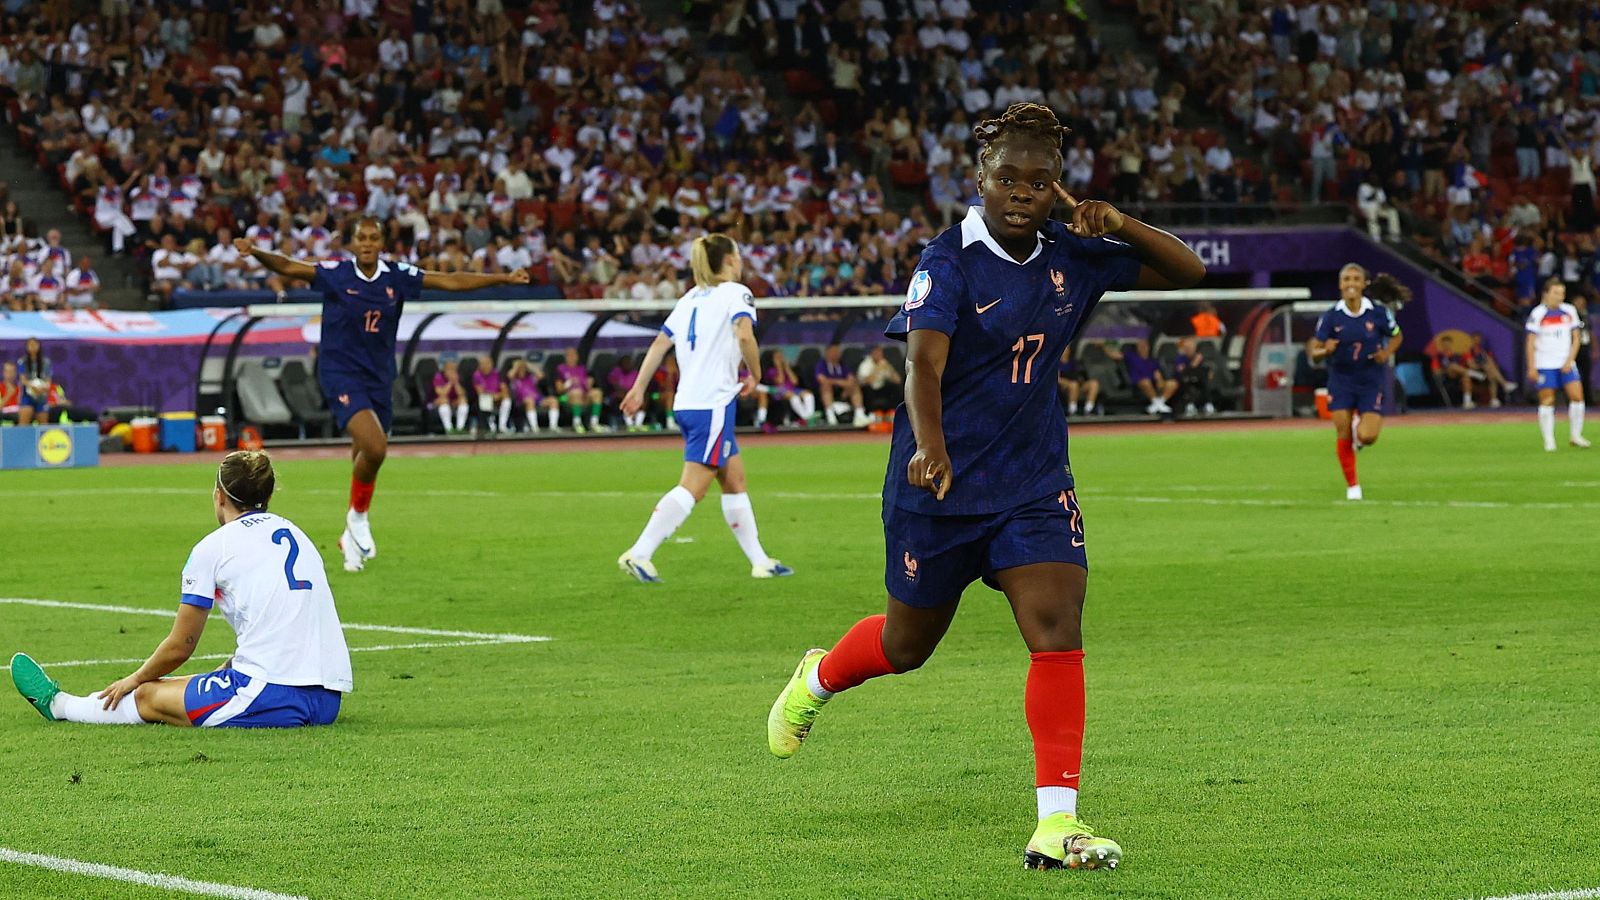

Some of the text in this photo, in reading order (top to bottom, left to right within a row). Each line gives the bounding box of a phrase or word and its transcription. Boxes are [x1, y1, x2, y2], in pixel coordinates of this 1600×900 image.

[1187, 240, 1230, 266] CH
[364, 309, 382, 332] 12
[687, 306, 697, 351] 4
[1011, 333, 1045, 384] 17
[1352, 341, 1362, 360] 7
[271, 528, 313, 590] 2
